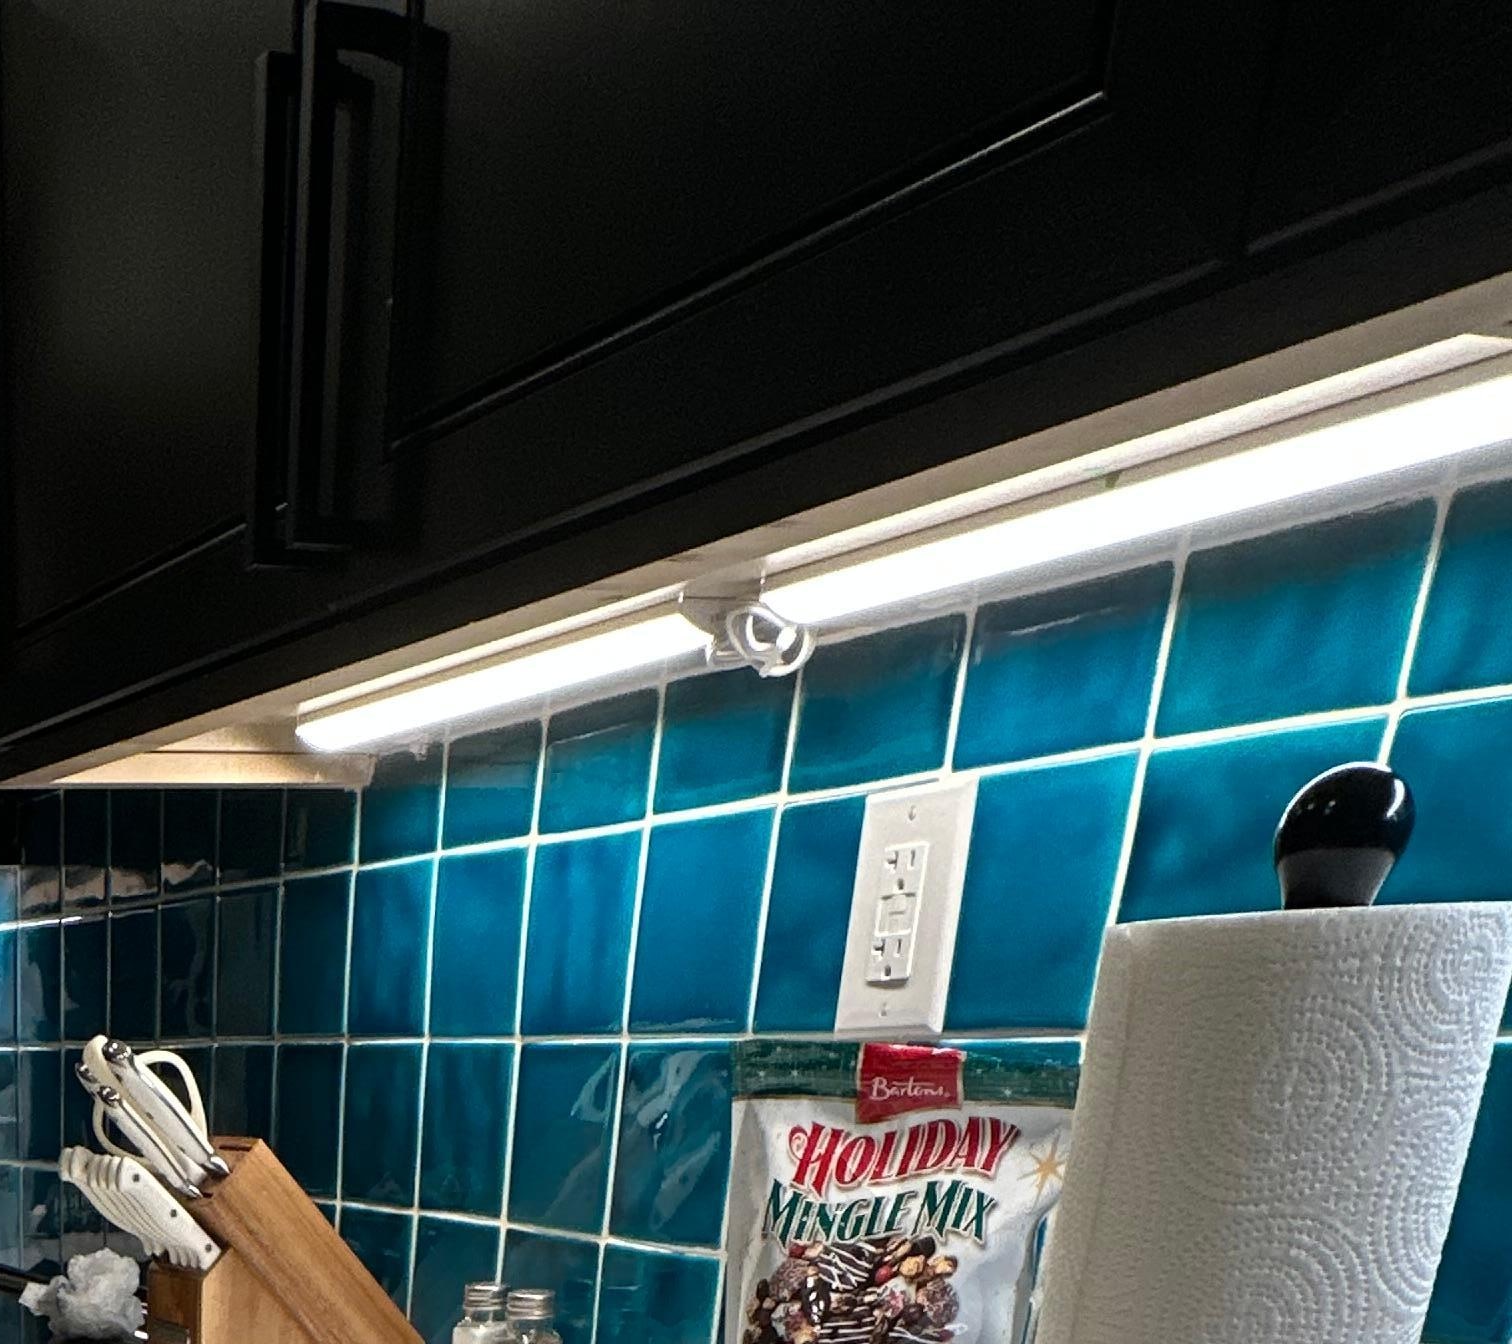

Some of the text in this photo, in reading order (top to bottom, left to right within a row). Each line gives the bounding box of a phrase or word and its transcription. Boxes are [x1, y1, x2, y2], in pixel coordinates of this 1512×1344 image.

[788, 1115, 1021, 1200] HOLIDAY
[762, 1177, 996, 1250] MINGLE MIX
